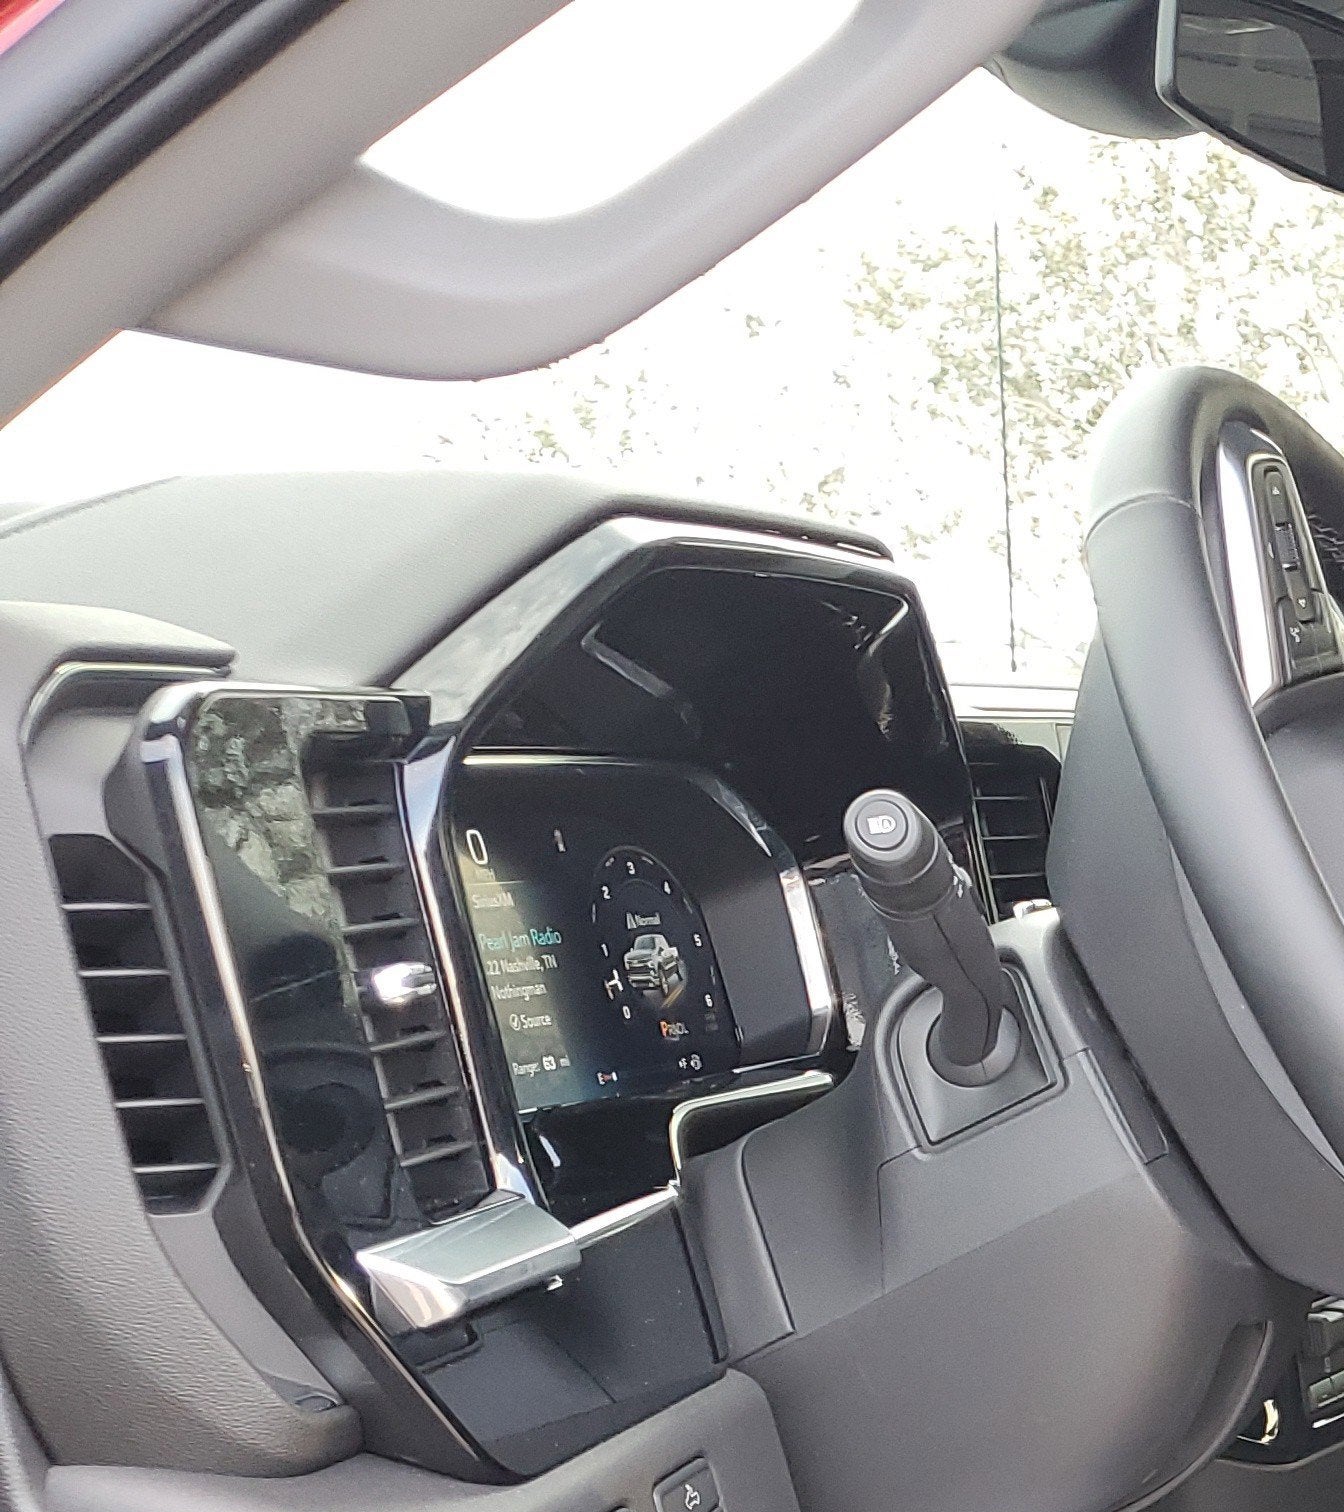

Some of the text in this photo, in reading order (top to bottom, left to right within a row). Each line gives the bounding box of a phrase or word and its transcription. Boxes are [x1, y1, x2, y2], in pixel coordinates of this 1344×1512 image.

[466, 829, 489, 865] 0
[626, 861, 635, 875] 3
[601, 885, 611, 899] 2
[478, 926, 562, 952] Pearl Jam Radio
[693, 933, 703, 947] 5
[705, 993, 713, 1007] 6
[622, 1005, 631, 1020] 0
[520, 1014, 552, 1029] Source
